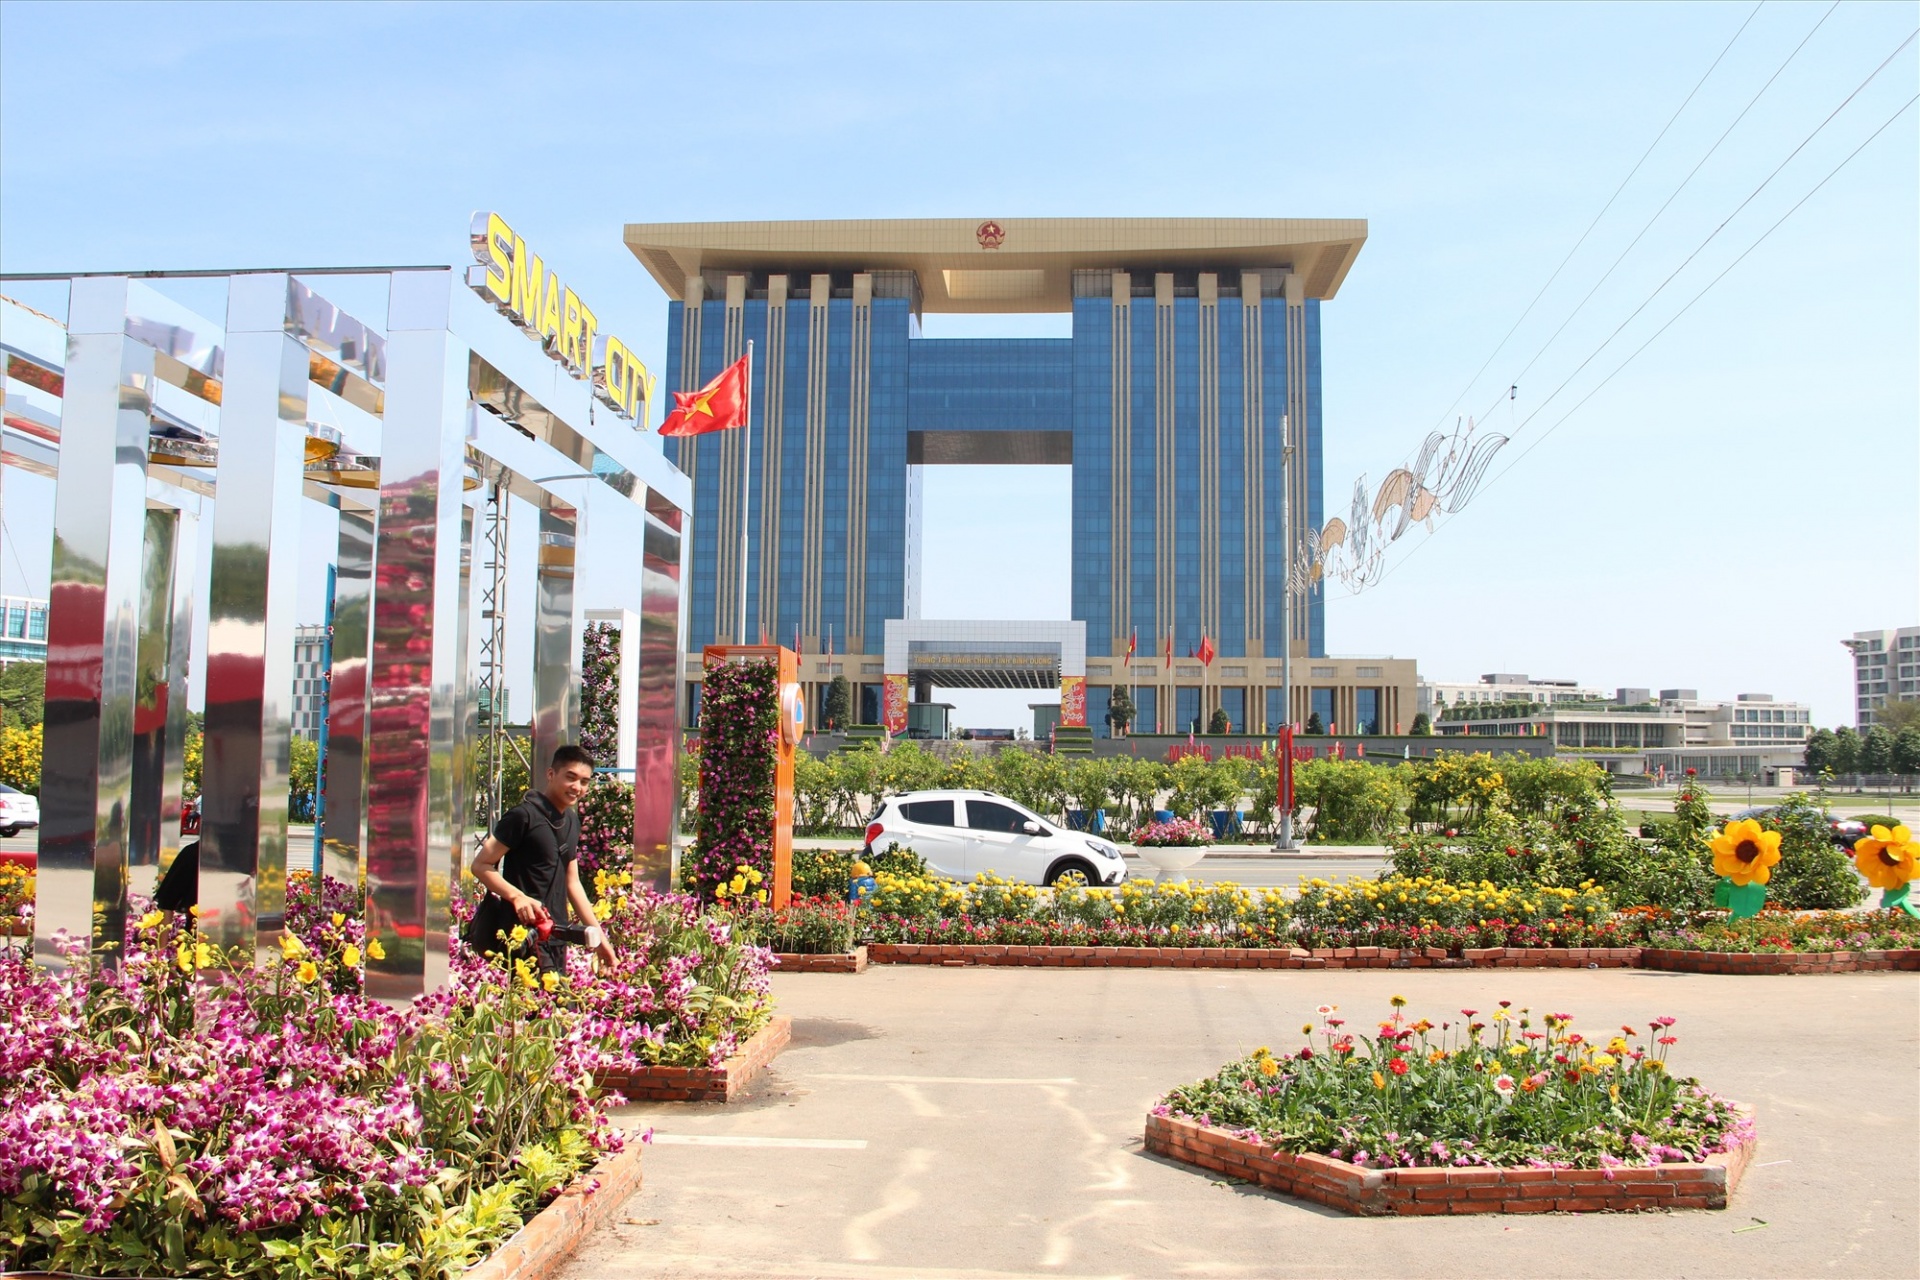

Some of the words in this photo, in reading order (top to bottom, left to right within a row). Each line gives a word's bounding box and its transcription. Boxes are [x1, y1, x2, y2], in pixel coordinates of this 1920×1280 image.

[478, 211, 598, 381] SMART
[599, 334, 657, 431] CITY
[1225, 739, 1263, 760] XUÂN
